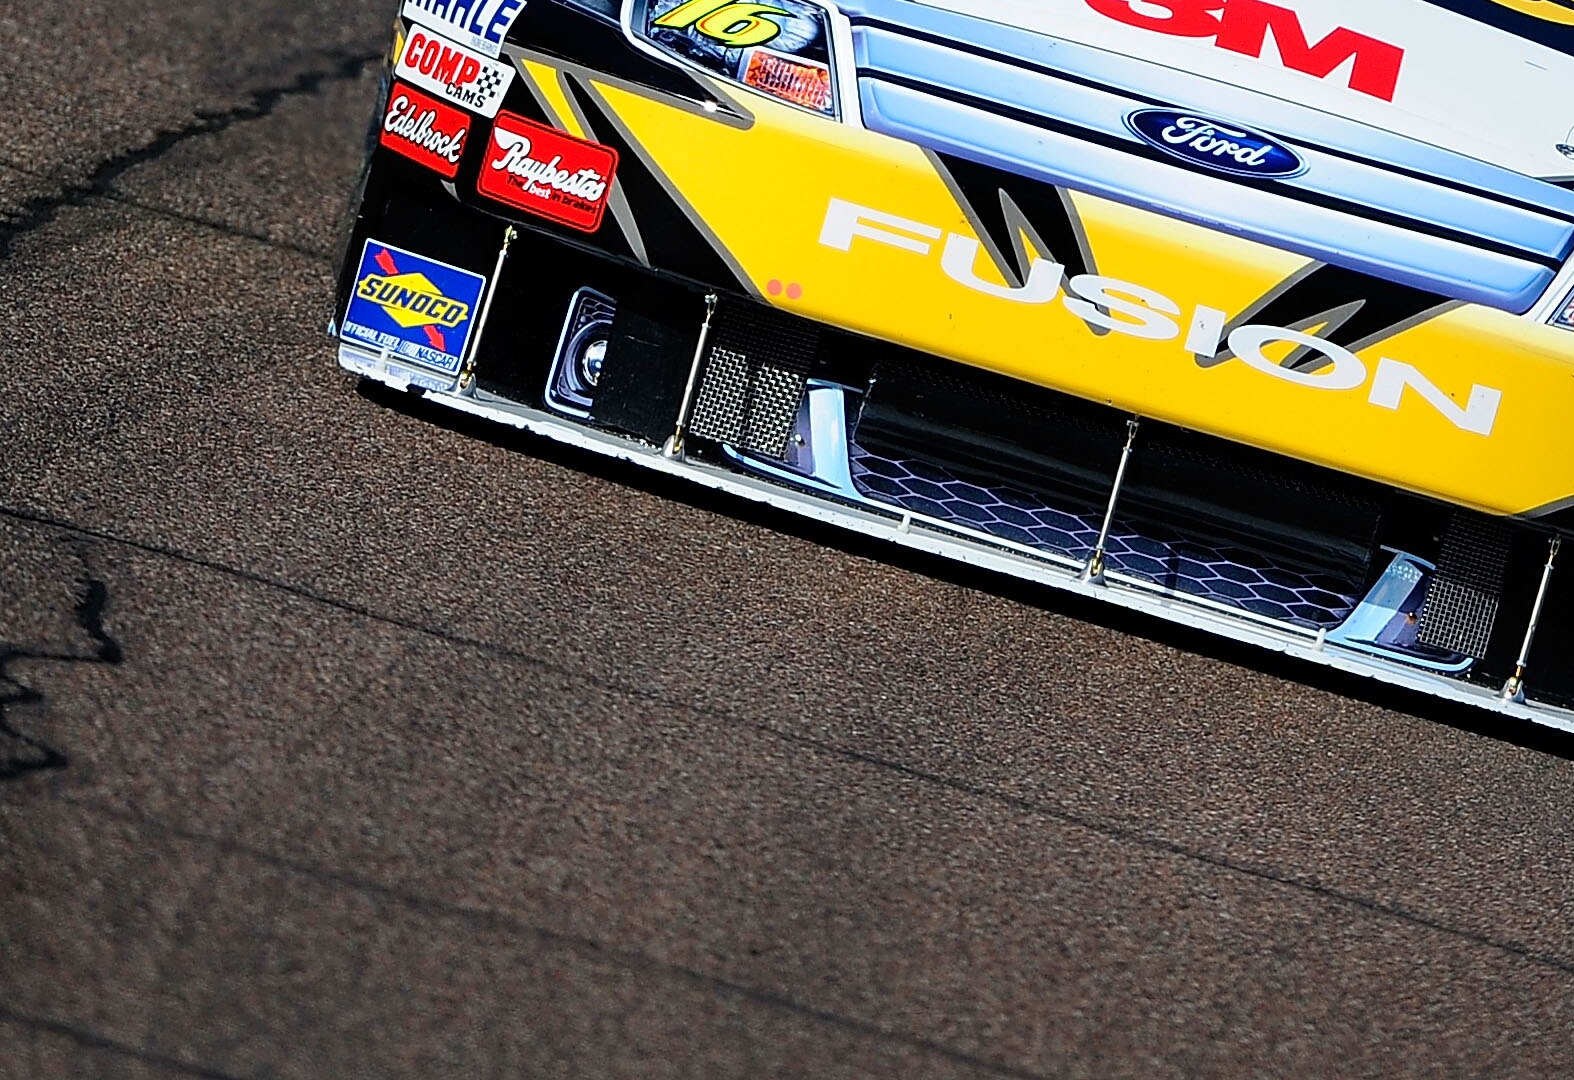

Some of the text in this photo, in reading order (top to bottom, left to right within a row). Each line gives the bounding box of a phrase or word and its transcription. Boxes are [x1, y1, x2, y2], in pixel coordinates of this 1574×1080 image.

[405, 33, 481, 87] COMP
[445, 82, 487, 108] CAMS
[385, 95, 466, 163] Edelbrock
[1161, 115, 1271, 168] Ford
[491, 126, 606, 201] Raybestos
[529, 185, 551, 199] best
[360, 278, 464, 324] SUNOCO
[818, 197, 1503, 436] FUSION
[378, 332, 401, 350] FUEL
[414, 346, 459, 369] NASCAR
